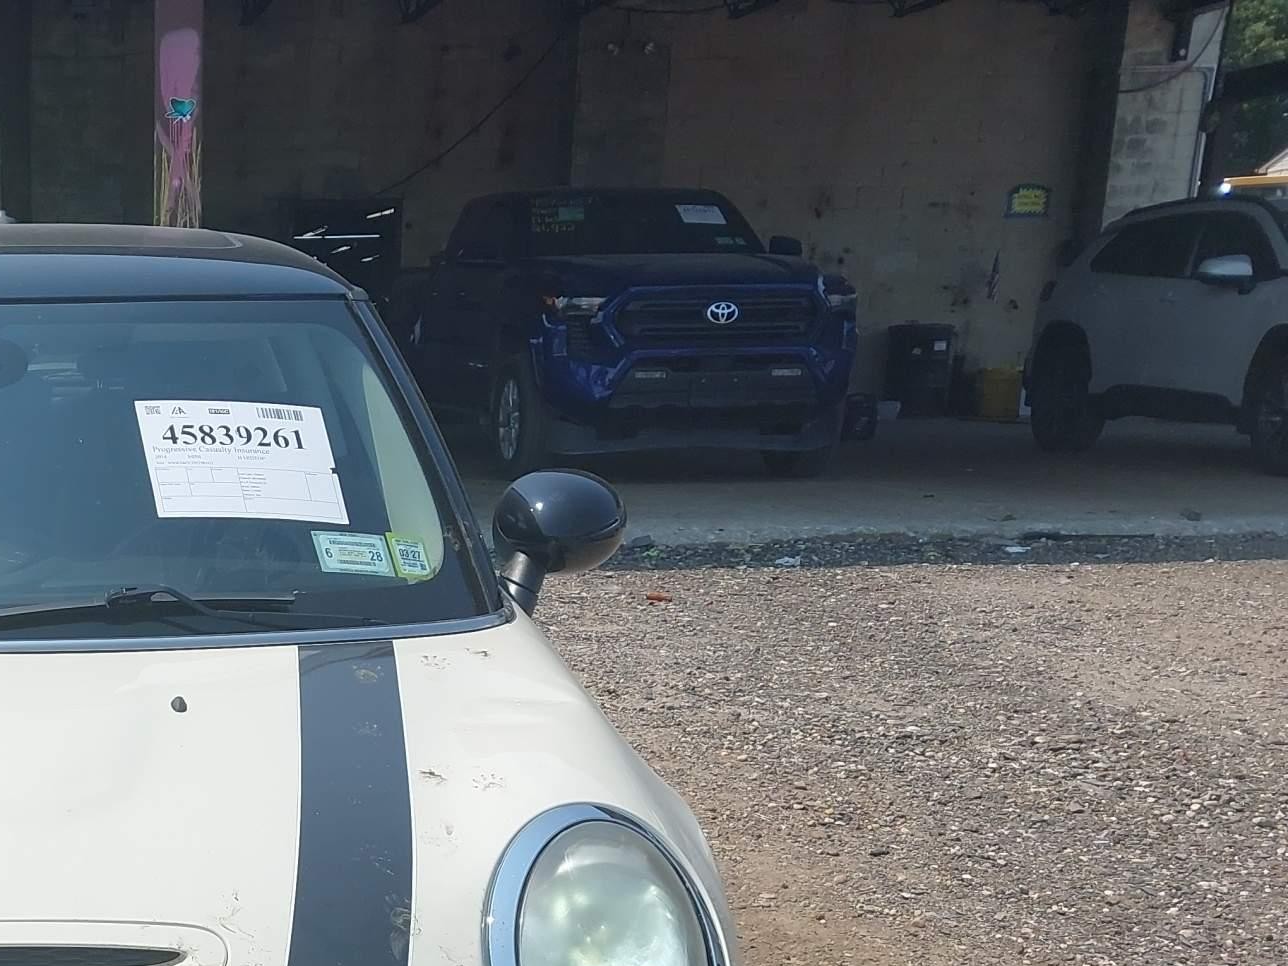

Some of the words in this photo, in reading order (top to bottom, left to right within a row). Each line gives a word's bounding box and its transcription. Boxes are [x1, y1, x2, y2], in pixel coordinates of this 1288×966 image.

[162, 424, 305, 450] 45839261
[152, 446, 197, 454] Progressive
[198, 446, 232, 455] Casualty
[325, 547, 333, 558] 6
[369, 551, 383, 562] 28
